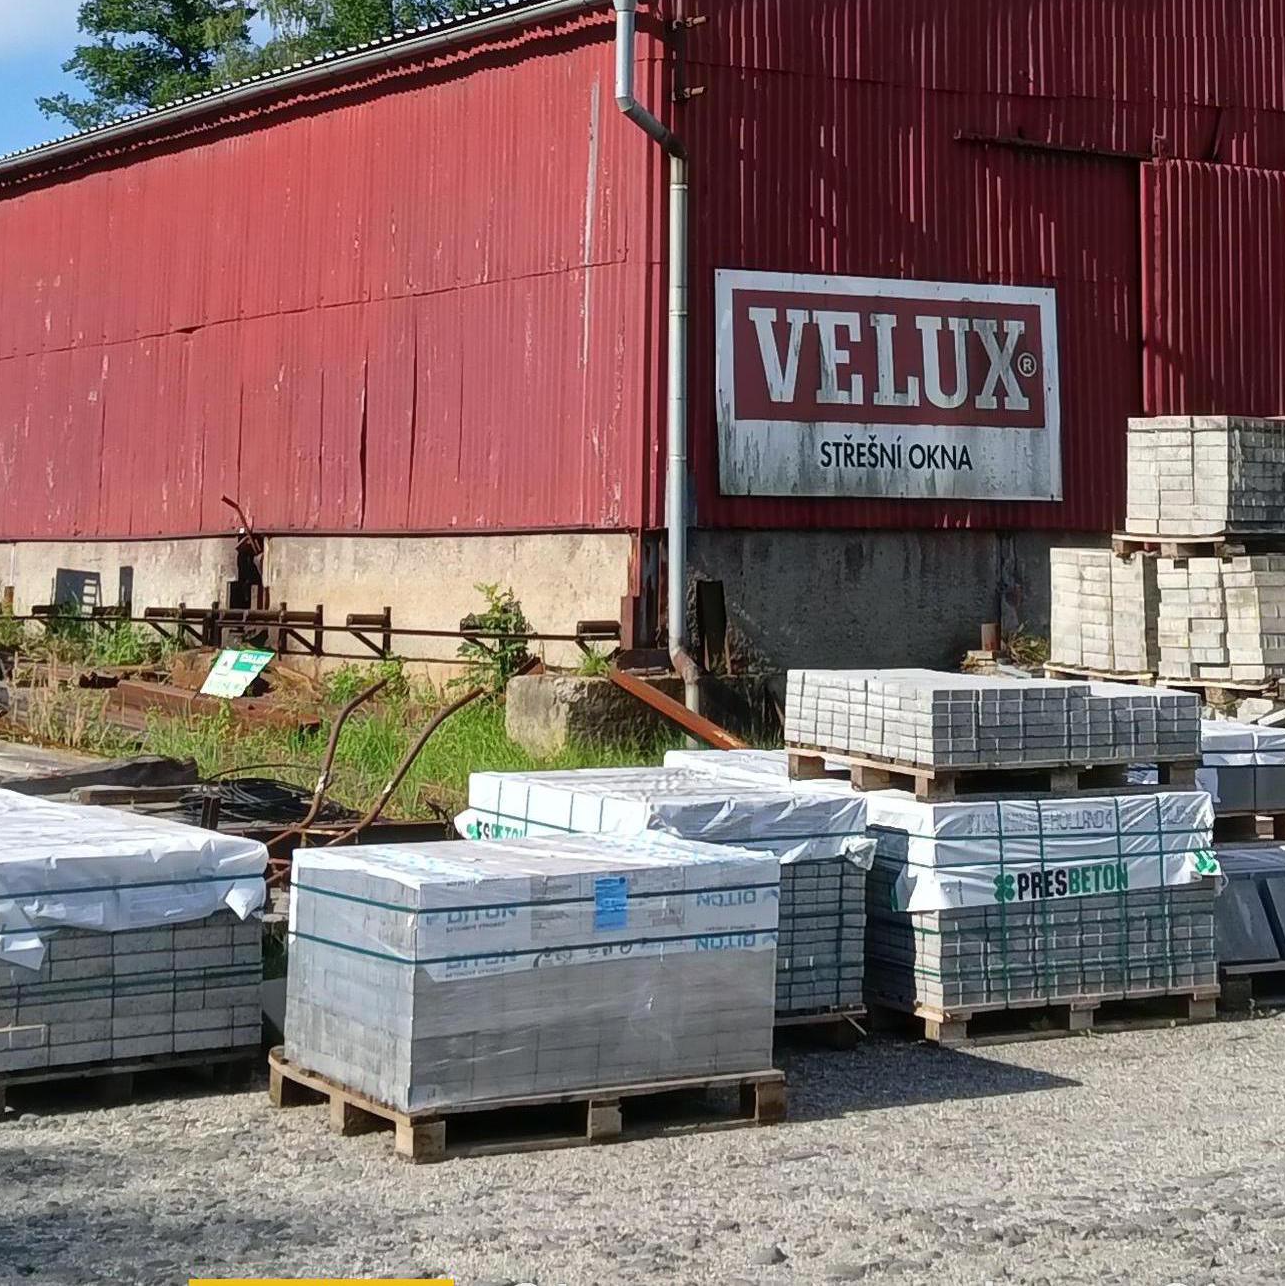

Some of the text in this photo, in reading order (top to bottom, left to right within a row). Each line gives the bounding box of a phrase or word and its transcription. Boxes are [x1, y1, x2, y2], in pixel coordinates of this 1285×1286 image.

[819, 435, 974, 472] STŘEŠNÍ OKNA
[1017, 863, 1129, 901] PRESBETON
